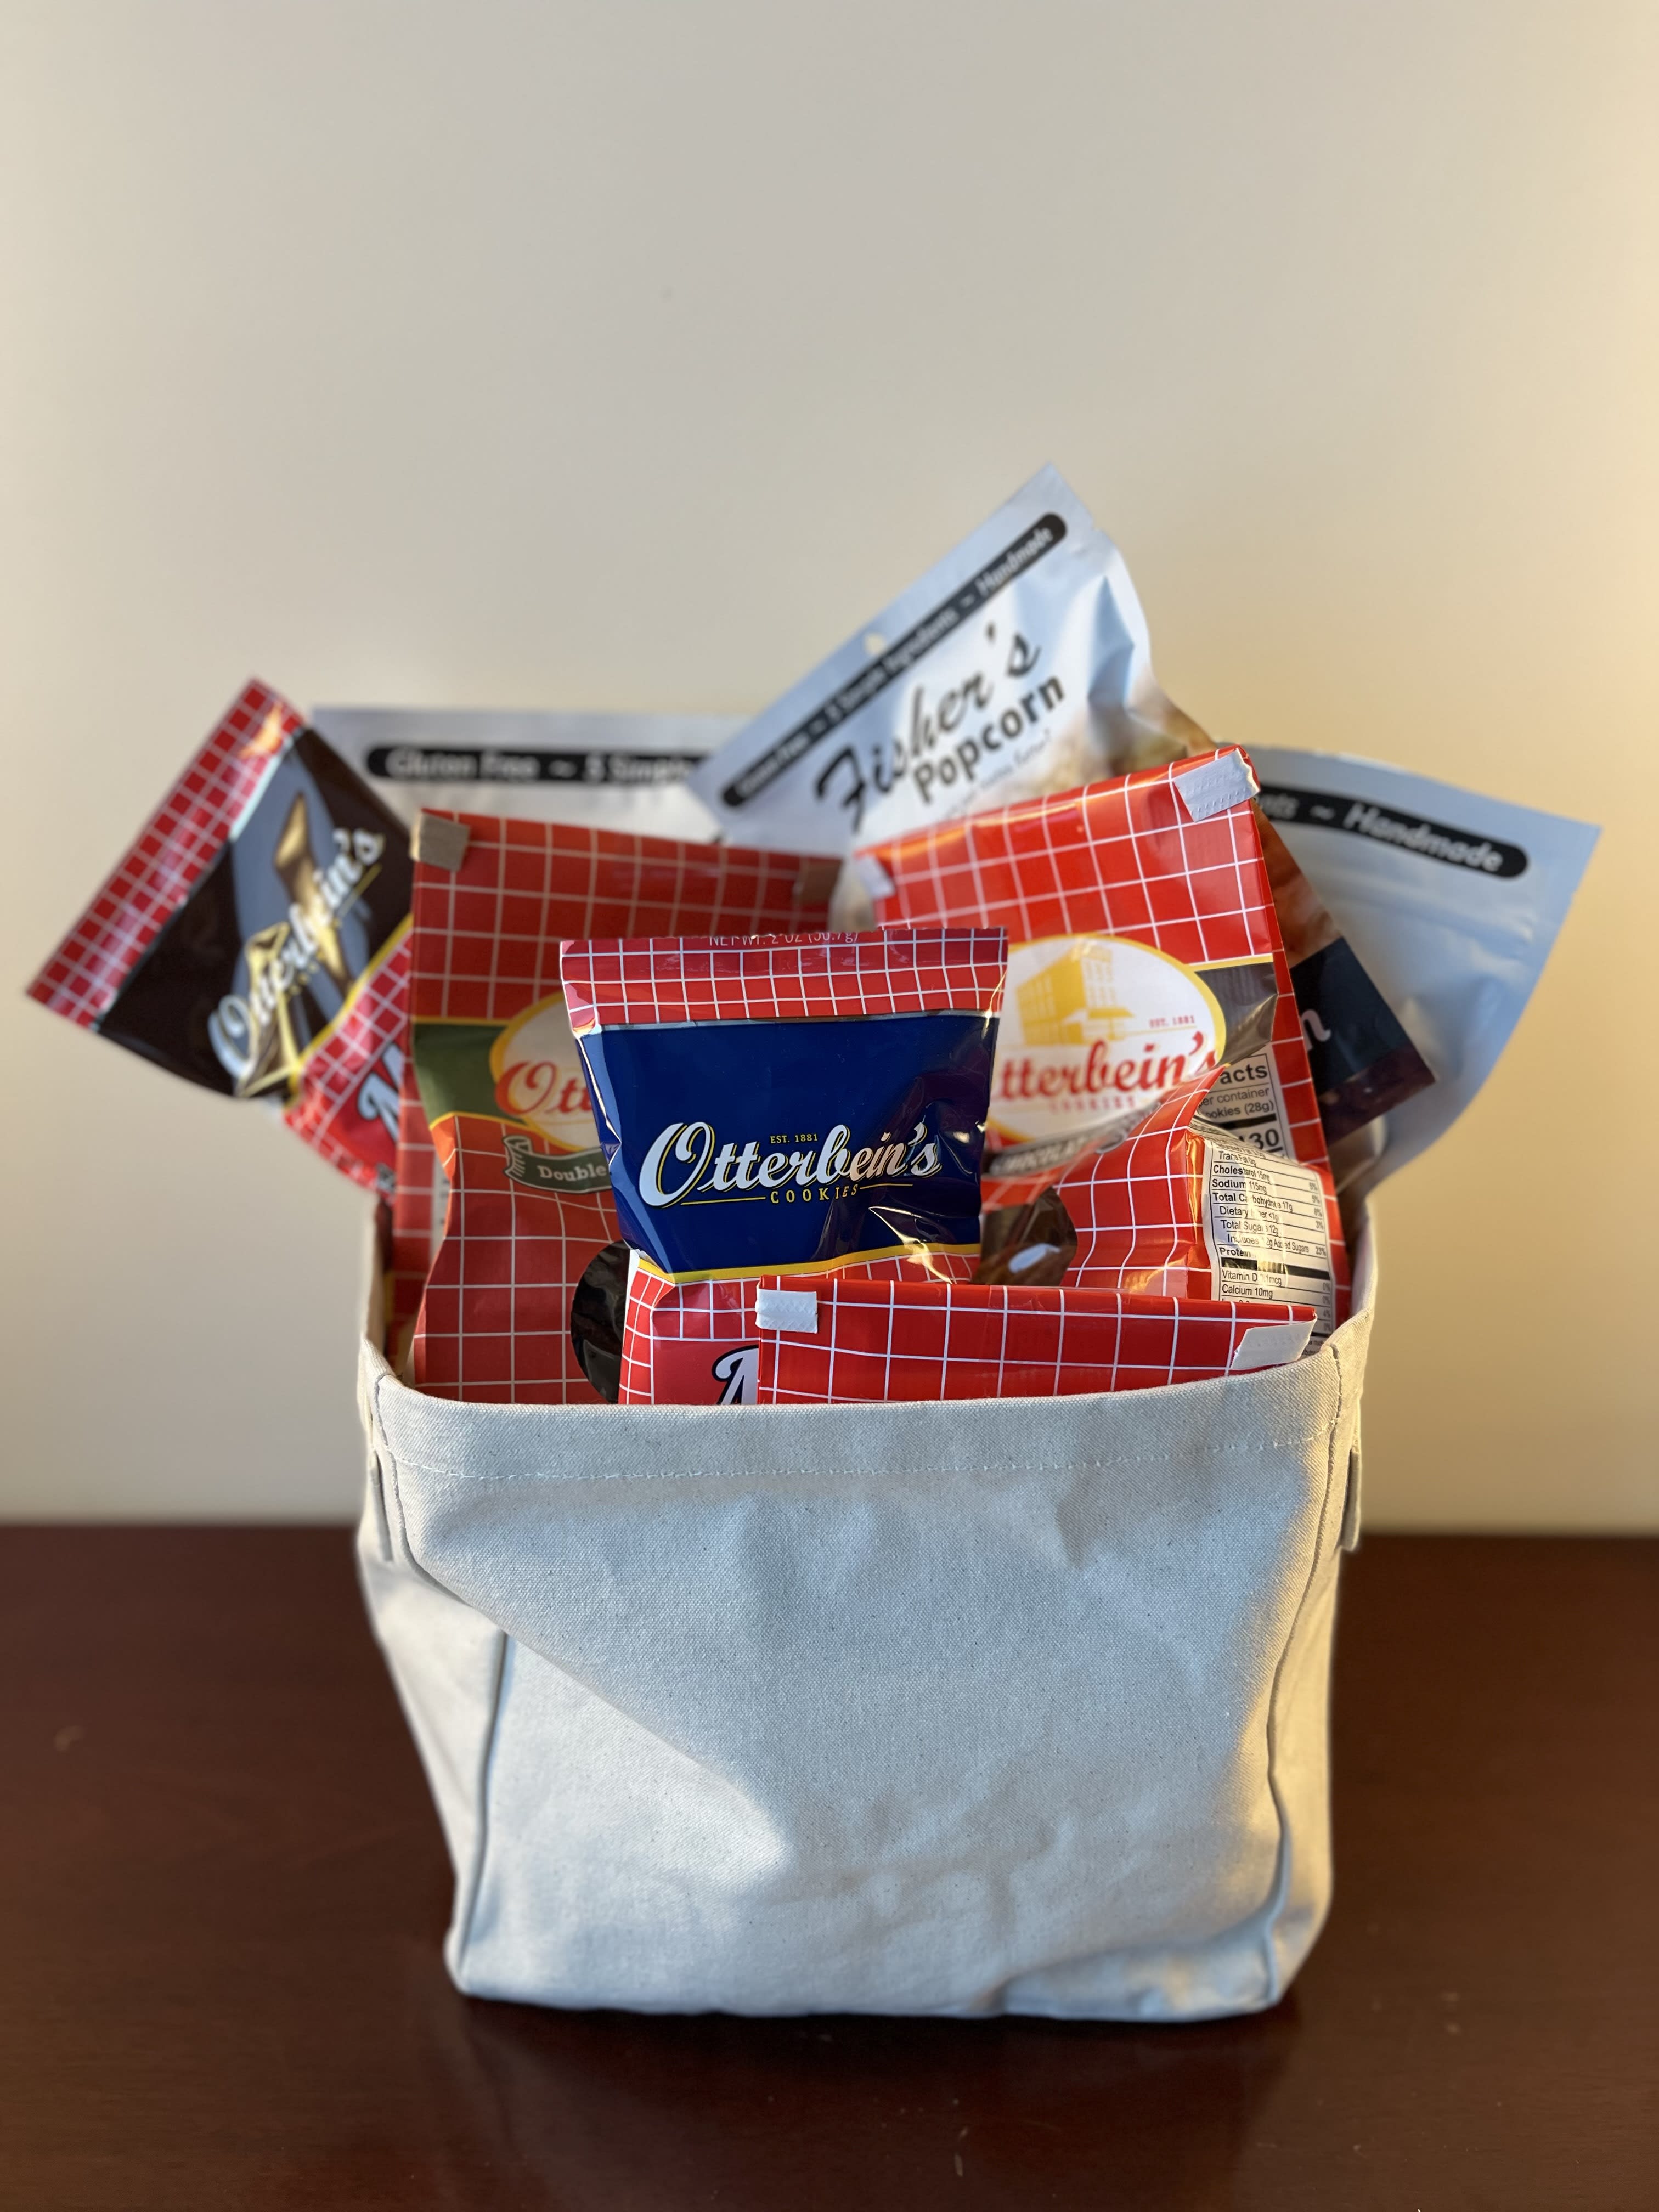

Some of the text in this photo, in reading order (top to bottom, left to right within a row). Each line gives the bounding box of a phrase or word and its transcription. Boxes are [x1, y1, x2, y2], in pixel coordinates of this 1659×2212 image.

[973, 523, 1056, 597] Handmade
[814, 622, 1041, 834] Fisher's
[911, 675, 1065, 805] Popcorn
[1342, 803, 1503, 872] Handmade
[997, 1030, 1216, 1101] tterbein's
[1220, 1064, 1268, 1085] acts
[1217, 1088, 1269, 1103] container
[1205, 1100, 1274, 1119] ookies (28g)
[770, 1133, 818, 1144] EST. 1881
[1238, 1128, 1279, 1149] 30
[639, 1121, 943, 1209] Otterbein's
[1218, 1151, 1239, 1161] Trans
[1239, 1155, 1249, 1164] Fat
[537, 1158, 607, 1182] Double
[1213, 1164, 1255, 1177] Cholesterol
[1257, 1171, 1270, 1184] 15mg
[770, 1184, 859, 1204] COOKIES
[1212, 1178, 1246, 1189] Sodium
[1249, 1181, 1267, 1194] 115mg
[1212, 1192, 1237, 1202] Total
[1239, 1193, 1281, 1209] Cbohydrate
[1282, 1201, 1293, 1212] 17g
[1220, 1206, 1249, 1219] Dietary
[1221, 1220, 1241, 1229] Total
[1269, 1224, 1278, 1236] 12g
[1219, 1247, 1251, 1257] Protein
[1292, 1242, 1309, 1254] Sugars
[1315, 1246, 1326, 1256] 23%
[1222, 1269, 1250, 1281] Vitamin
[1252, 1272, 1257, 1282] D
[1260, 1273, 1282, 1286] .1mcg
[1222, 1284, 1252, 1296] Calcium
[1255, 1287, 1273, 1299] 10mg
